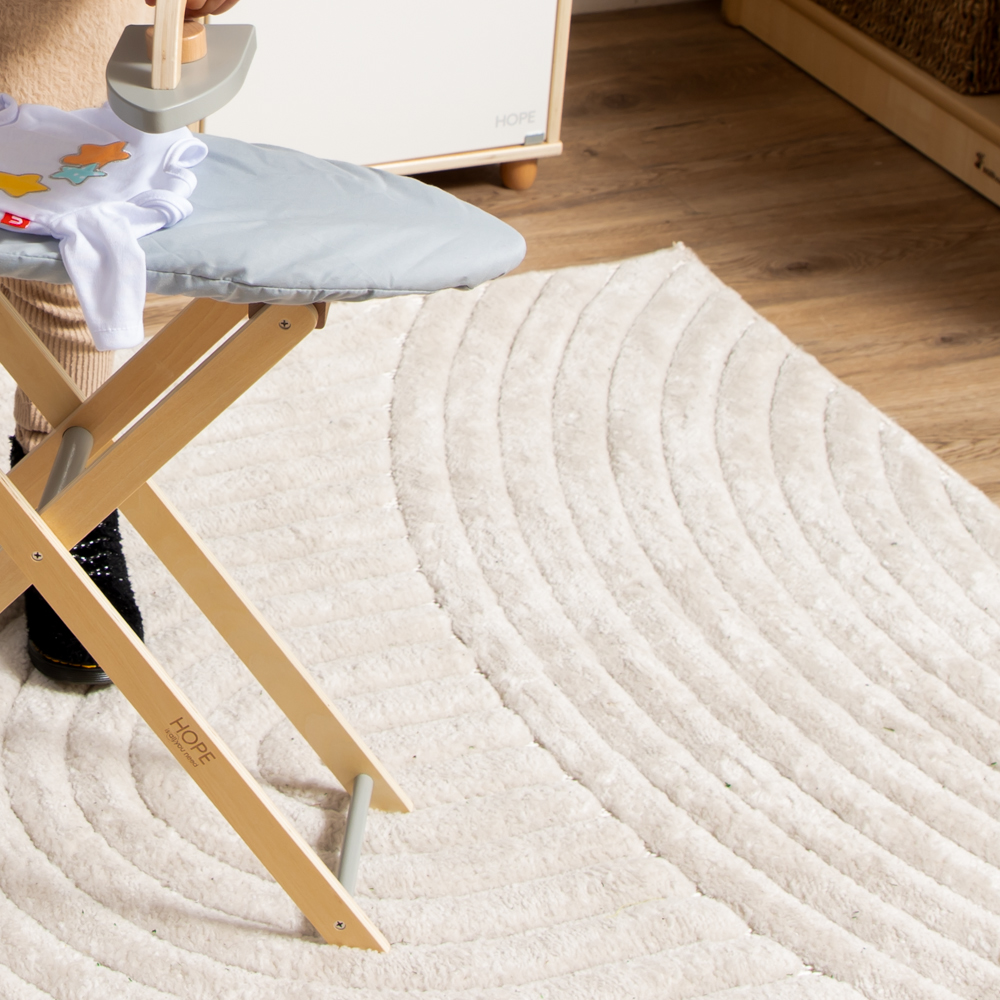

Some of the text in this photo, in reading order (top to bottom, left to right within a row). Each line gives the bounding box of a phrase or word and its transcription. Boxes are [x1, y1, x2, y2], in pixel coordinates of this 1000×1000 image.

[495, 110, 536, 128] HOPE
[169, 716, 216, 765] HOPE
[174, 741, 185, 752] you
